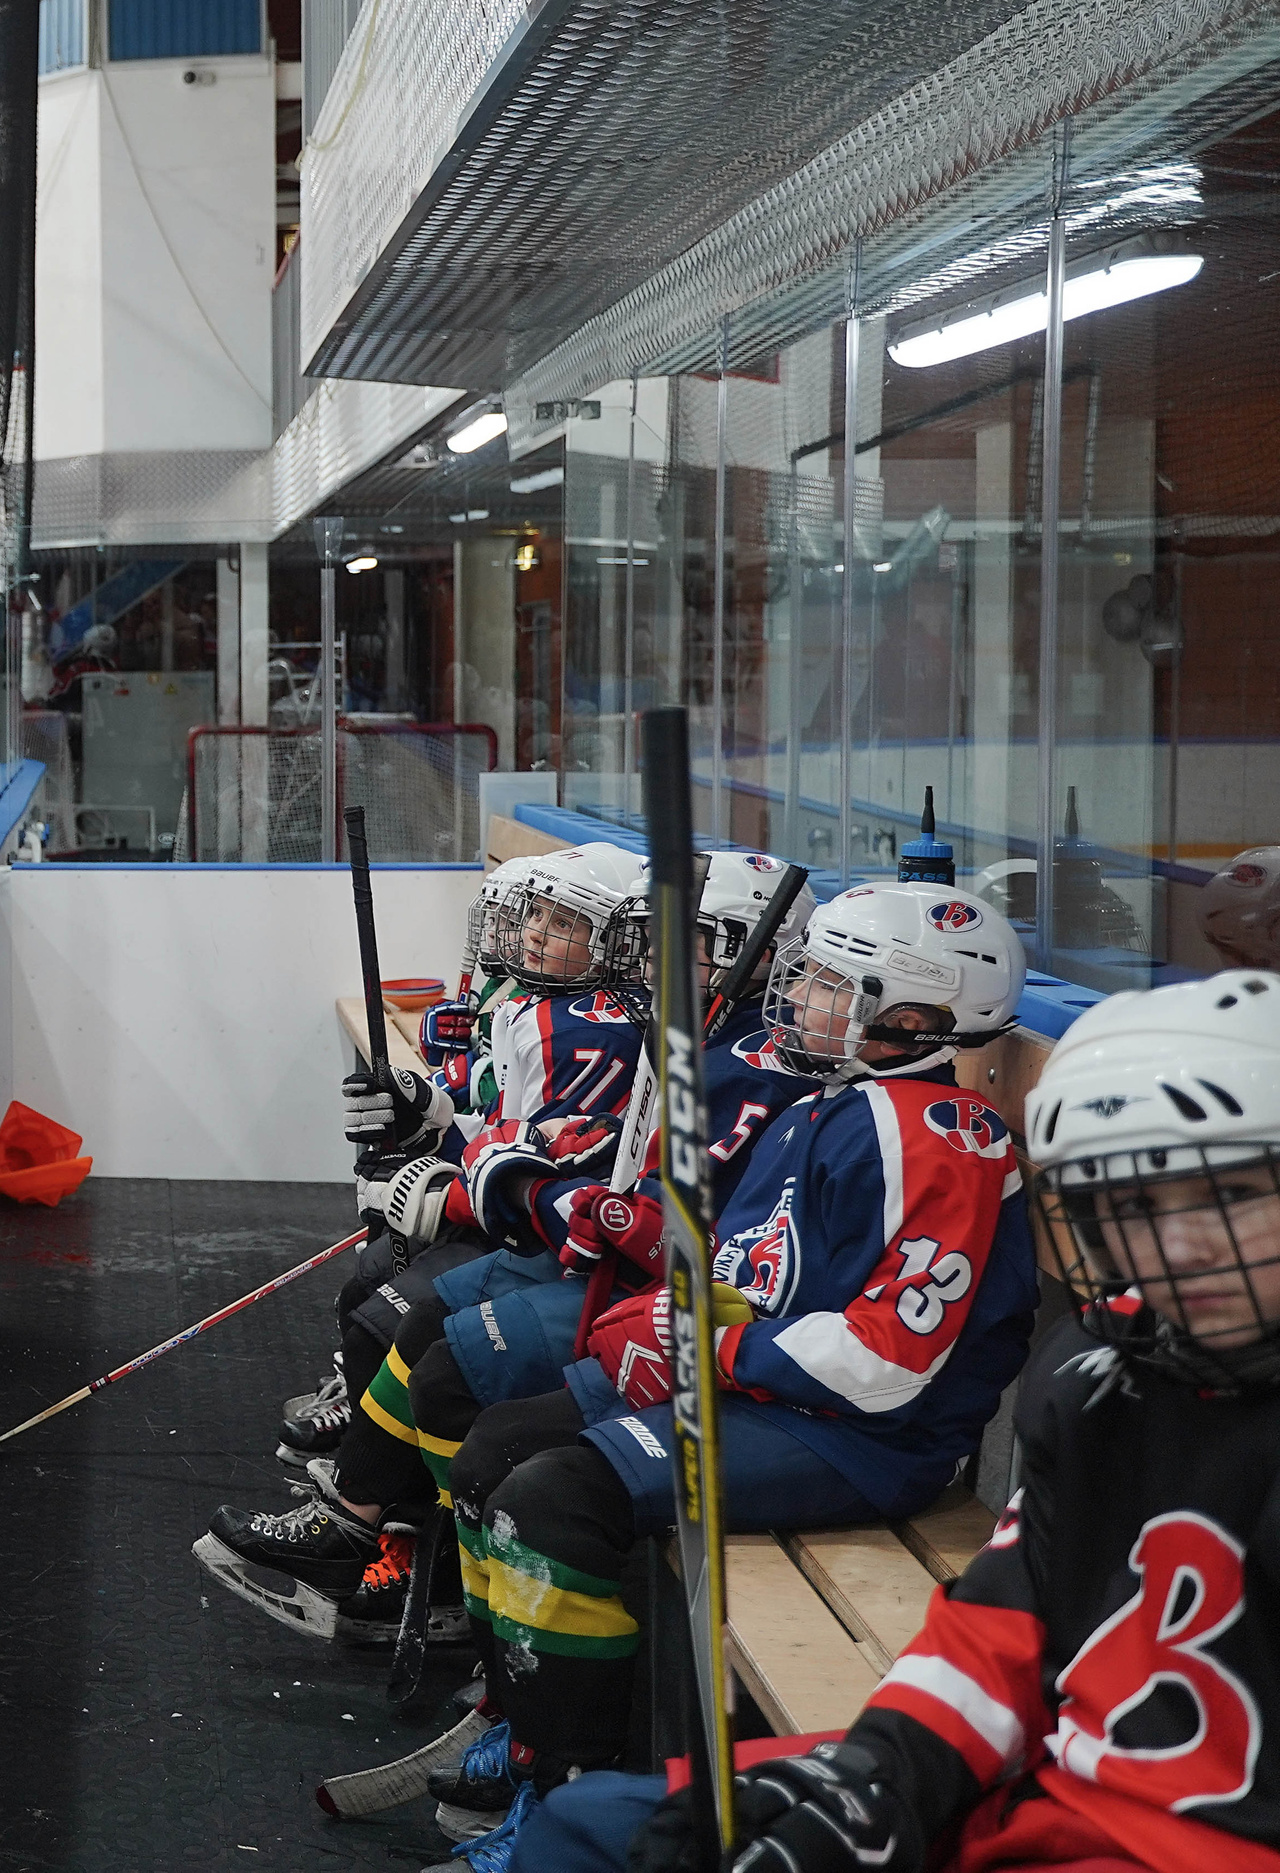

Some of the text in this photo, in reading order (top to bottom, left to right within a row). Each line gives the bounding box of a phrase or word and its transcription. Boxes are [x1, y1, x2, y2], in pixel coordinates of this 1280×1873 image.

[530, 868, 561, 883] BAUER
[900, 872, 948, 881] PASS
[555, 1048, 626, 1114] 71
[666, 1026, 697, 1187] CCM
[864, 1234, 973, 1337] 13
[673, 1309, 703, 1438] TACKS
